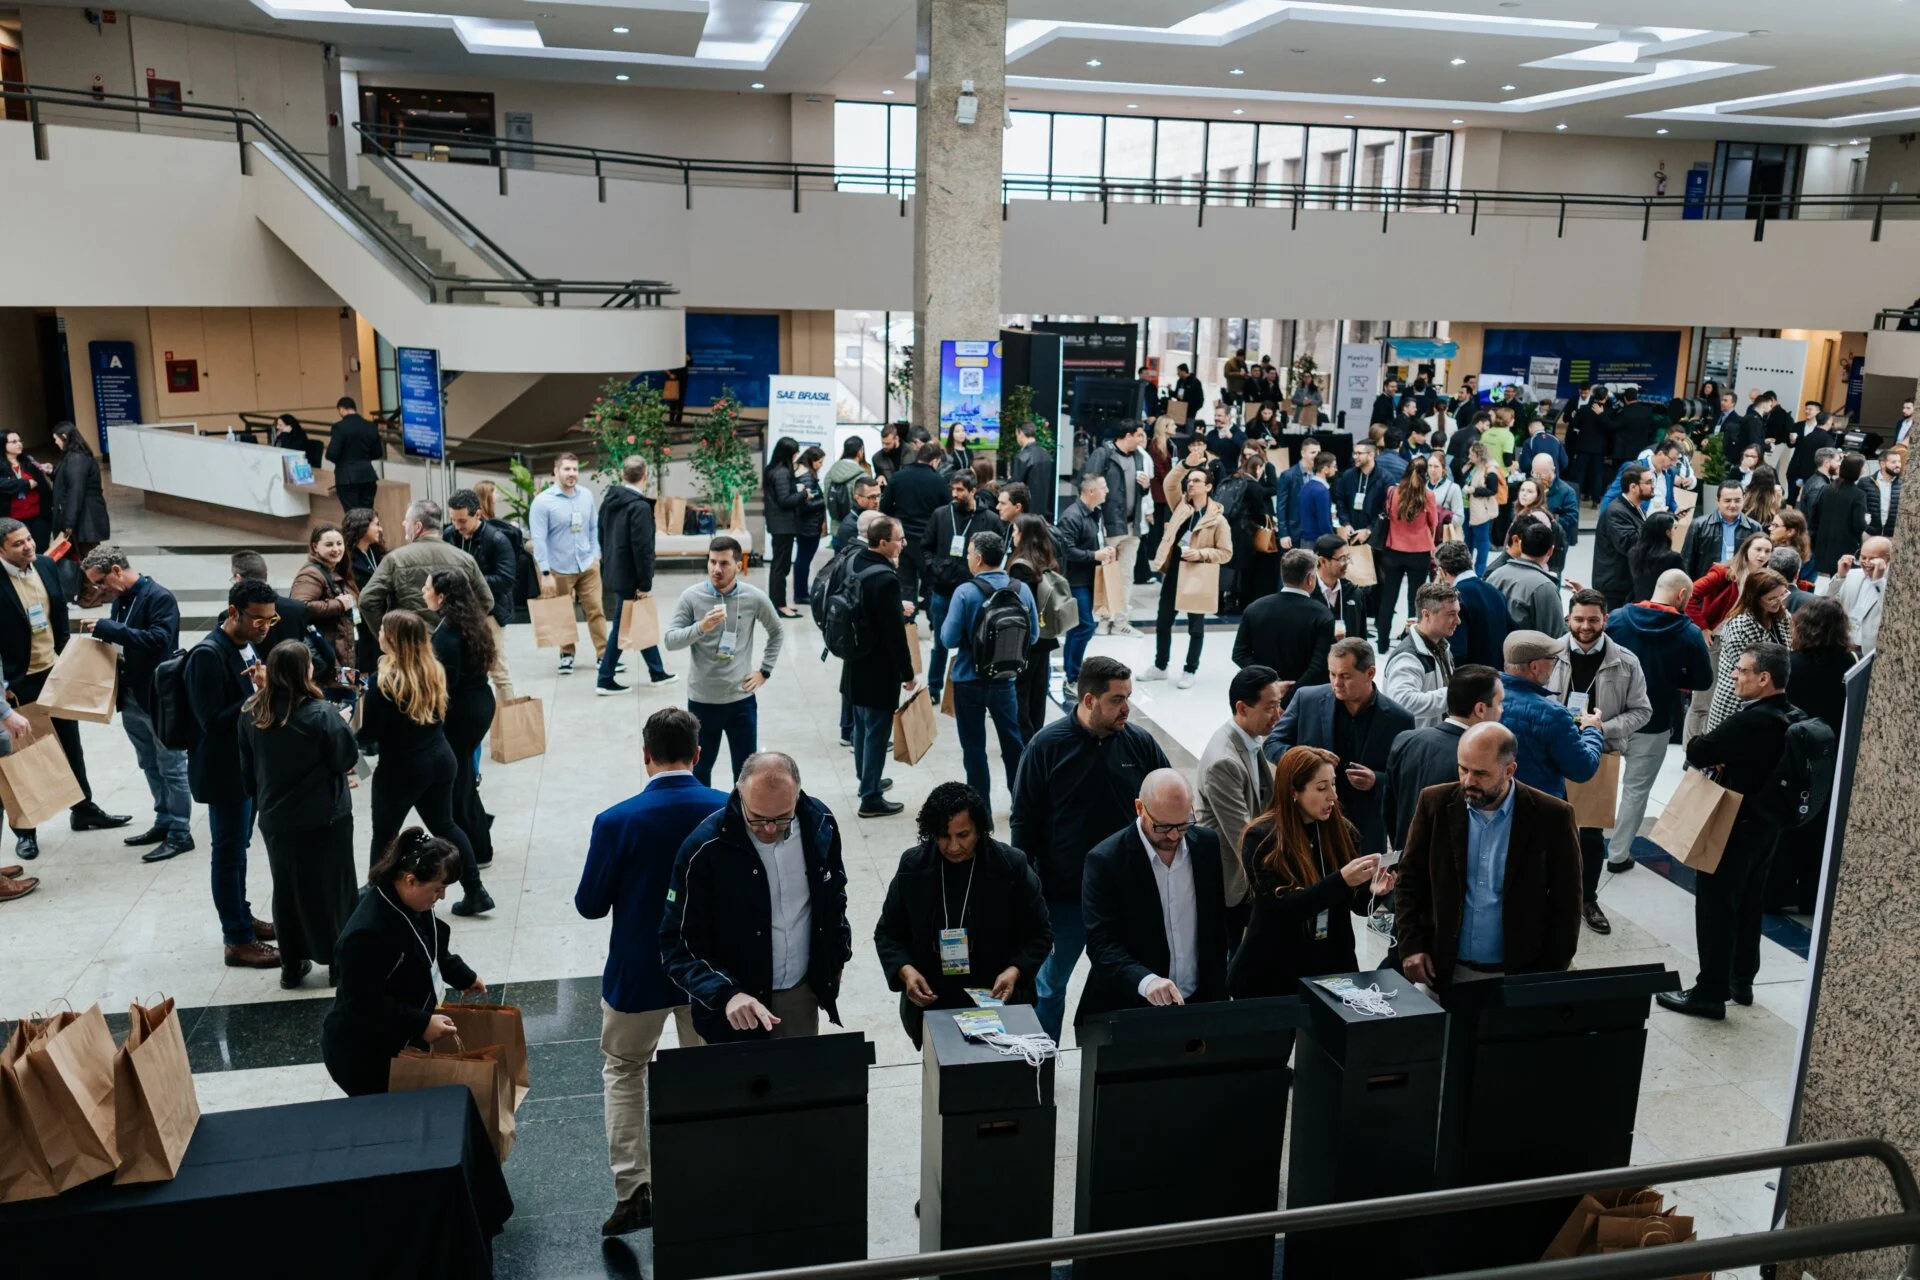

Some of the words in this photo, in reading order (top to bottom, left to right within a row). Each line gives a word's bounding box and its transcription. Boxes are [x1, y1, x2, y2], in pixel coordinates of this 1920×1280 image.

[109, 355, 123, 368] A
[775, 390, 797, 399] SAE
[798, 391, 832, 401] BRASIL
